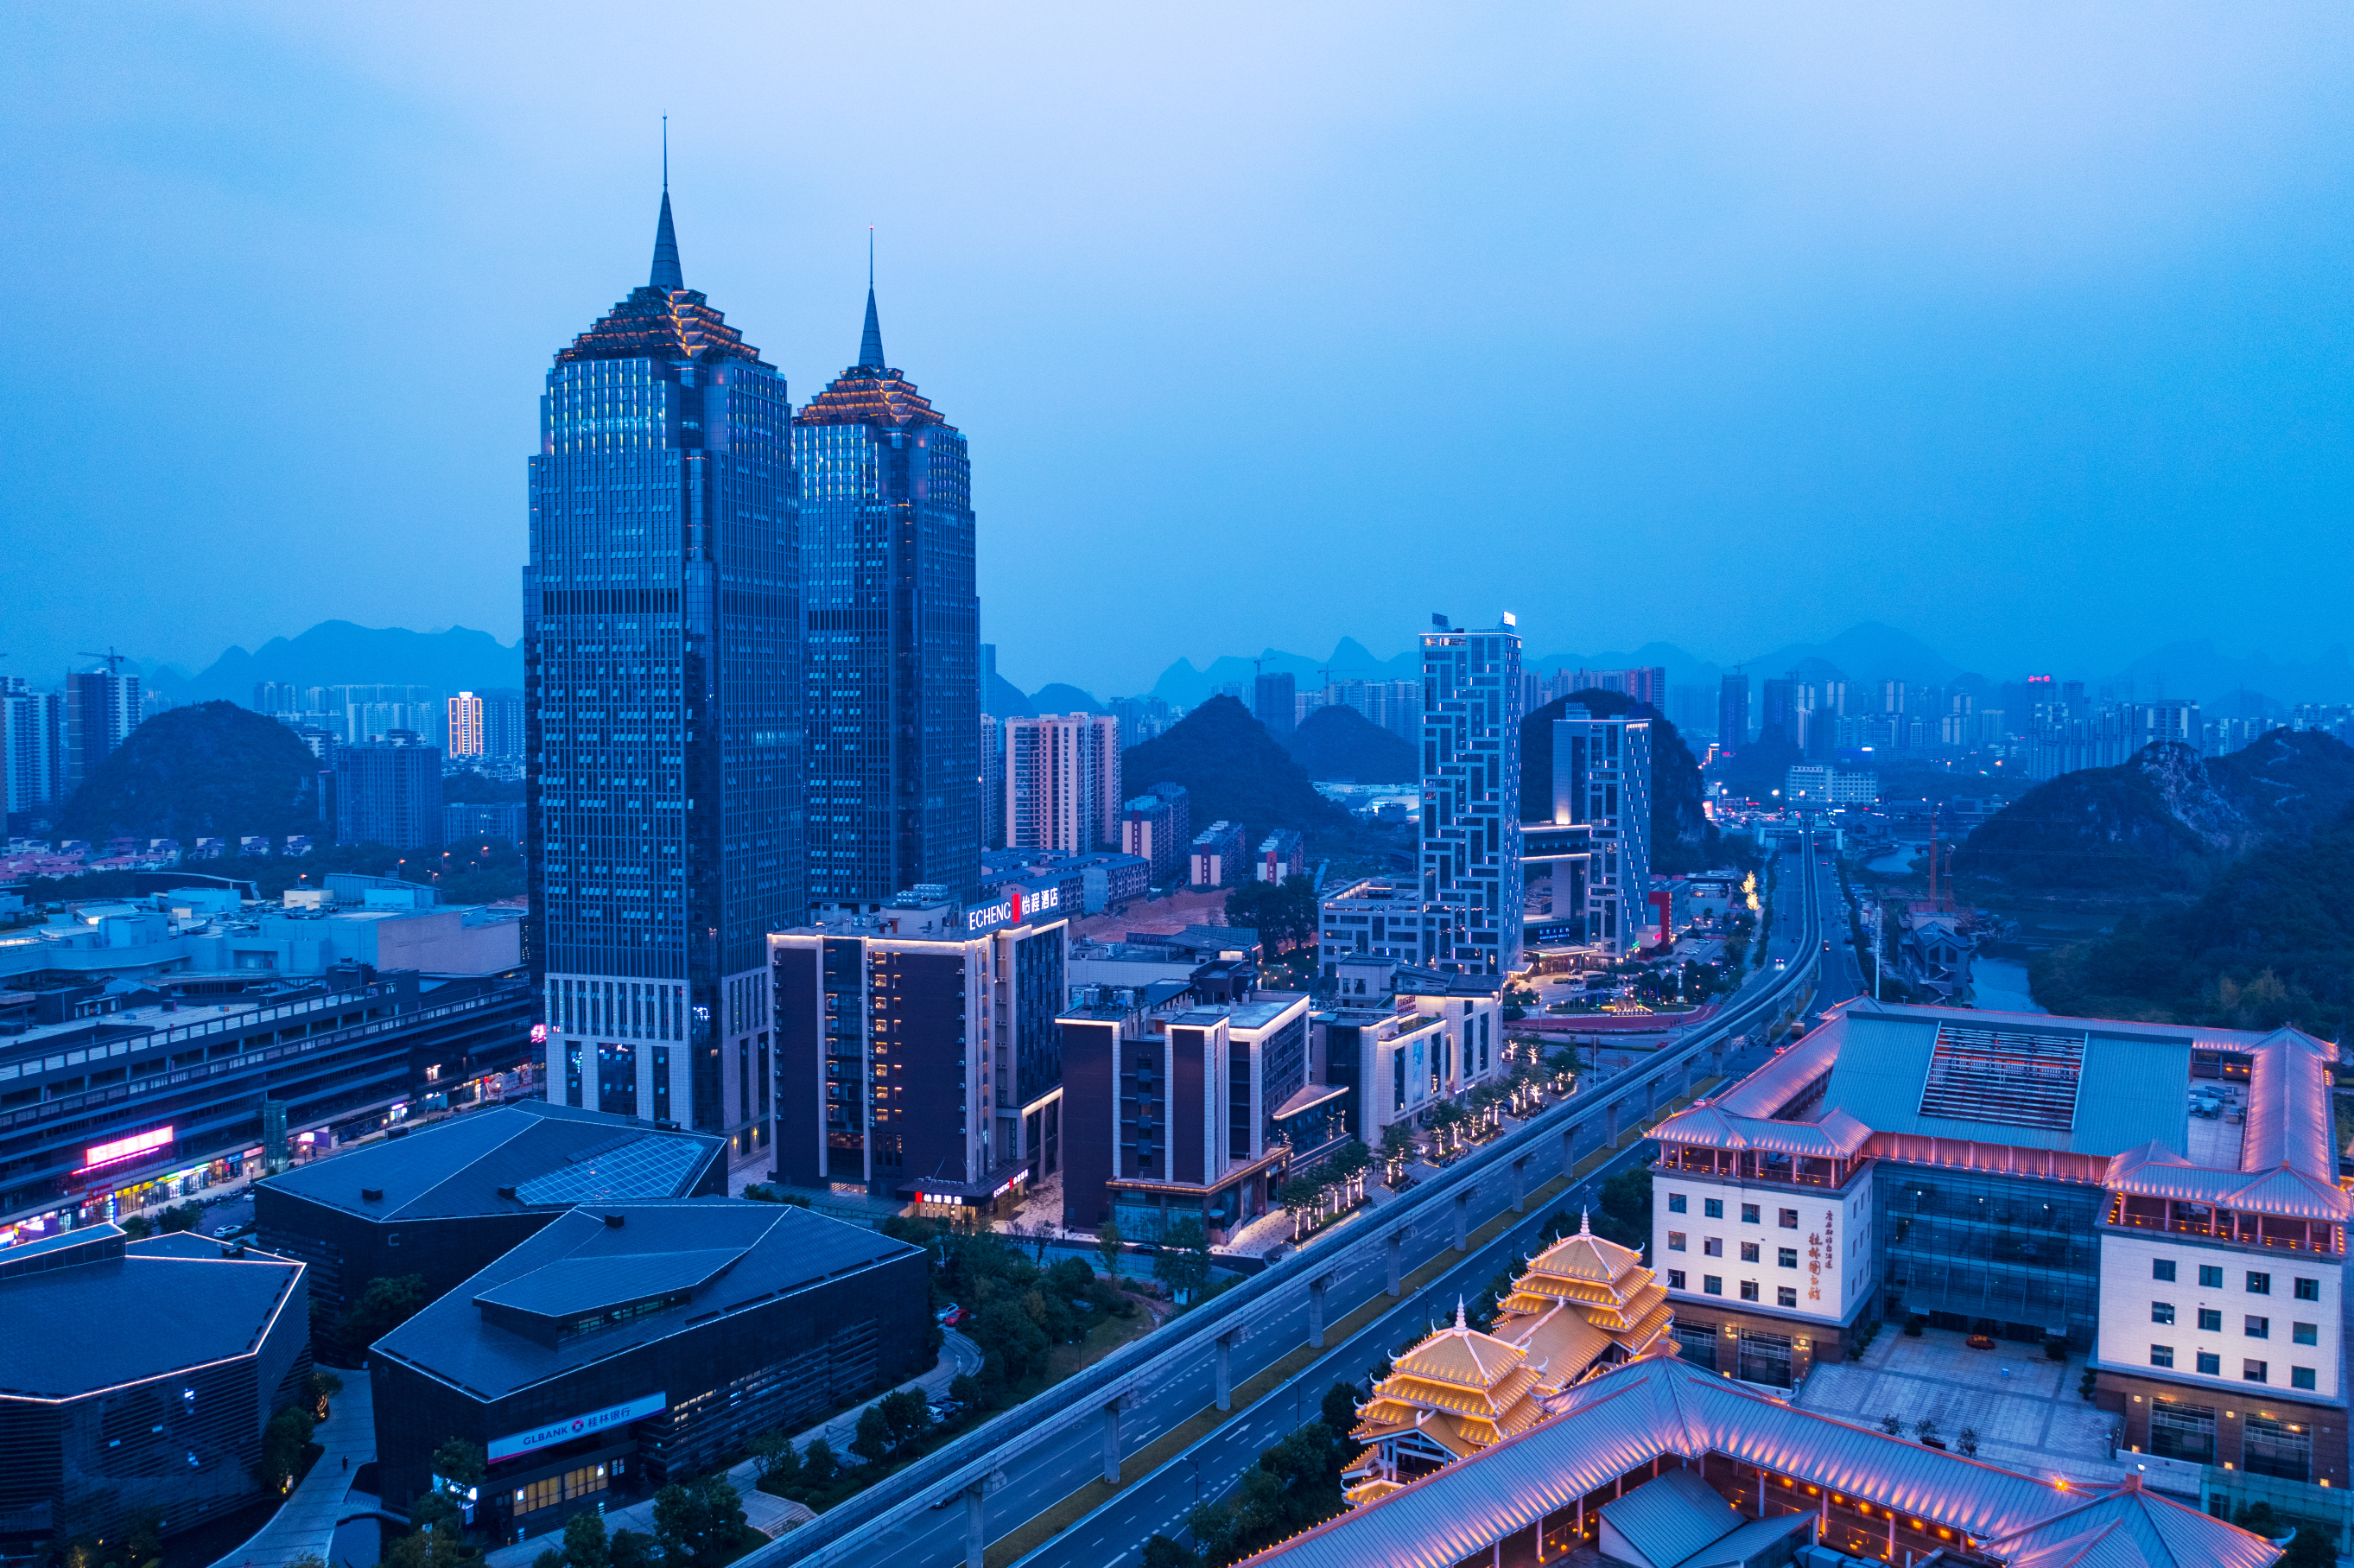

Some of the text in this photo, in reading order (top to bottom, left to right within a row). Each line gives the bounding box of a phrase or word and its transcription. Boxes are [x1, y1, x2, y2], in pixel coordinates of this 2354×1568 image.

[1022, 887, 1058, 916] 怡程酒店
[969, 902, 1012, 930] ECHENG
[587, 1406, 631, 1428] 桂林银行
[523, 1425, 568, 1445] GLBANK
